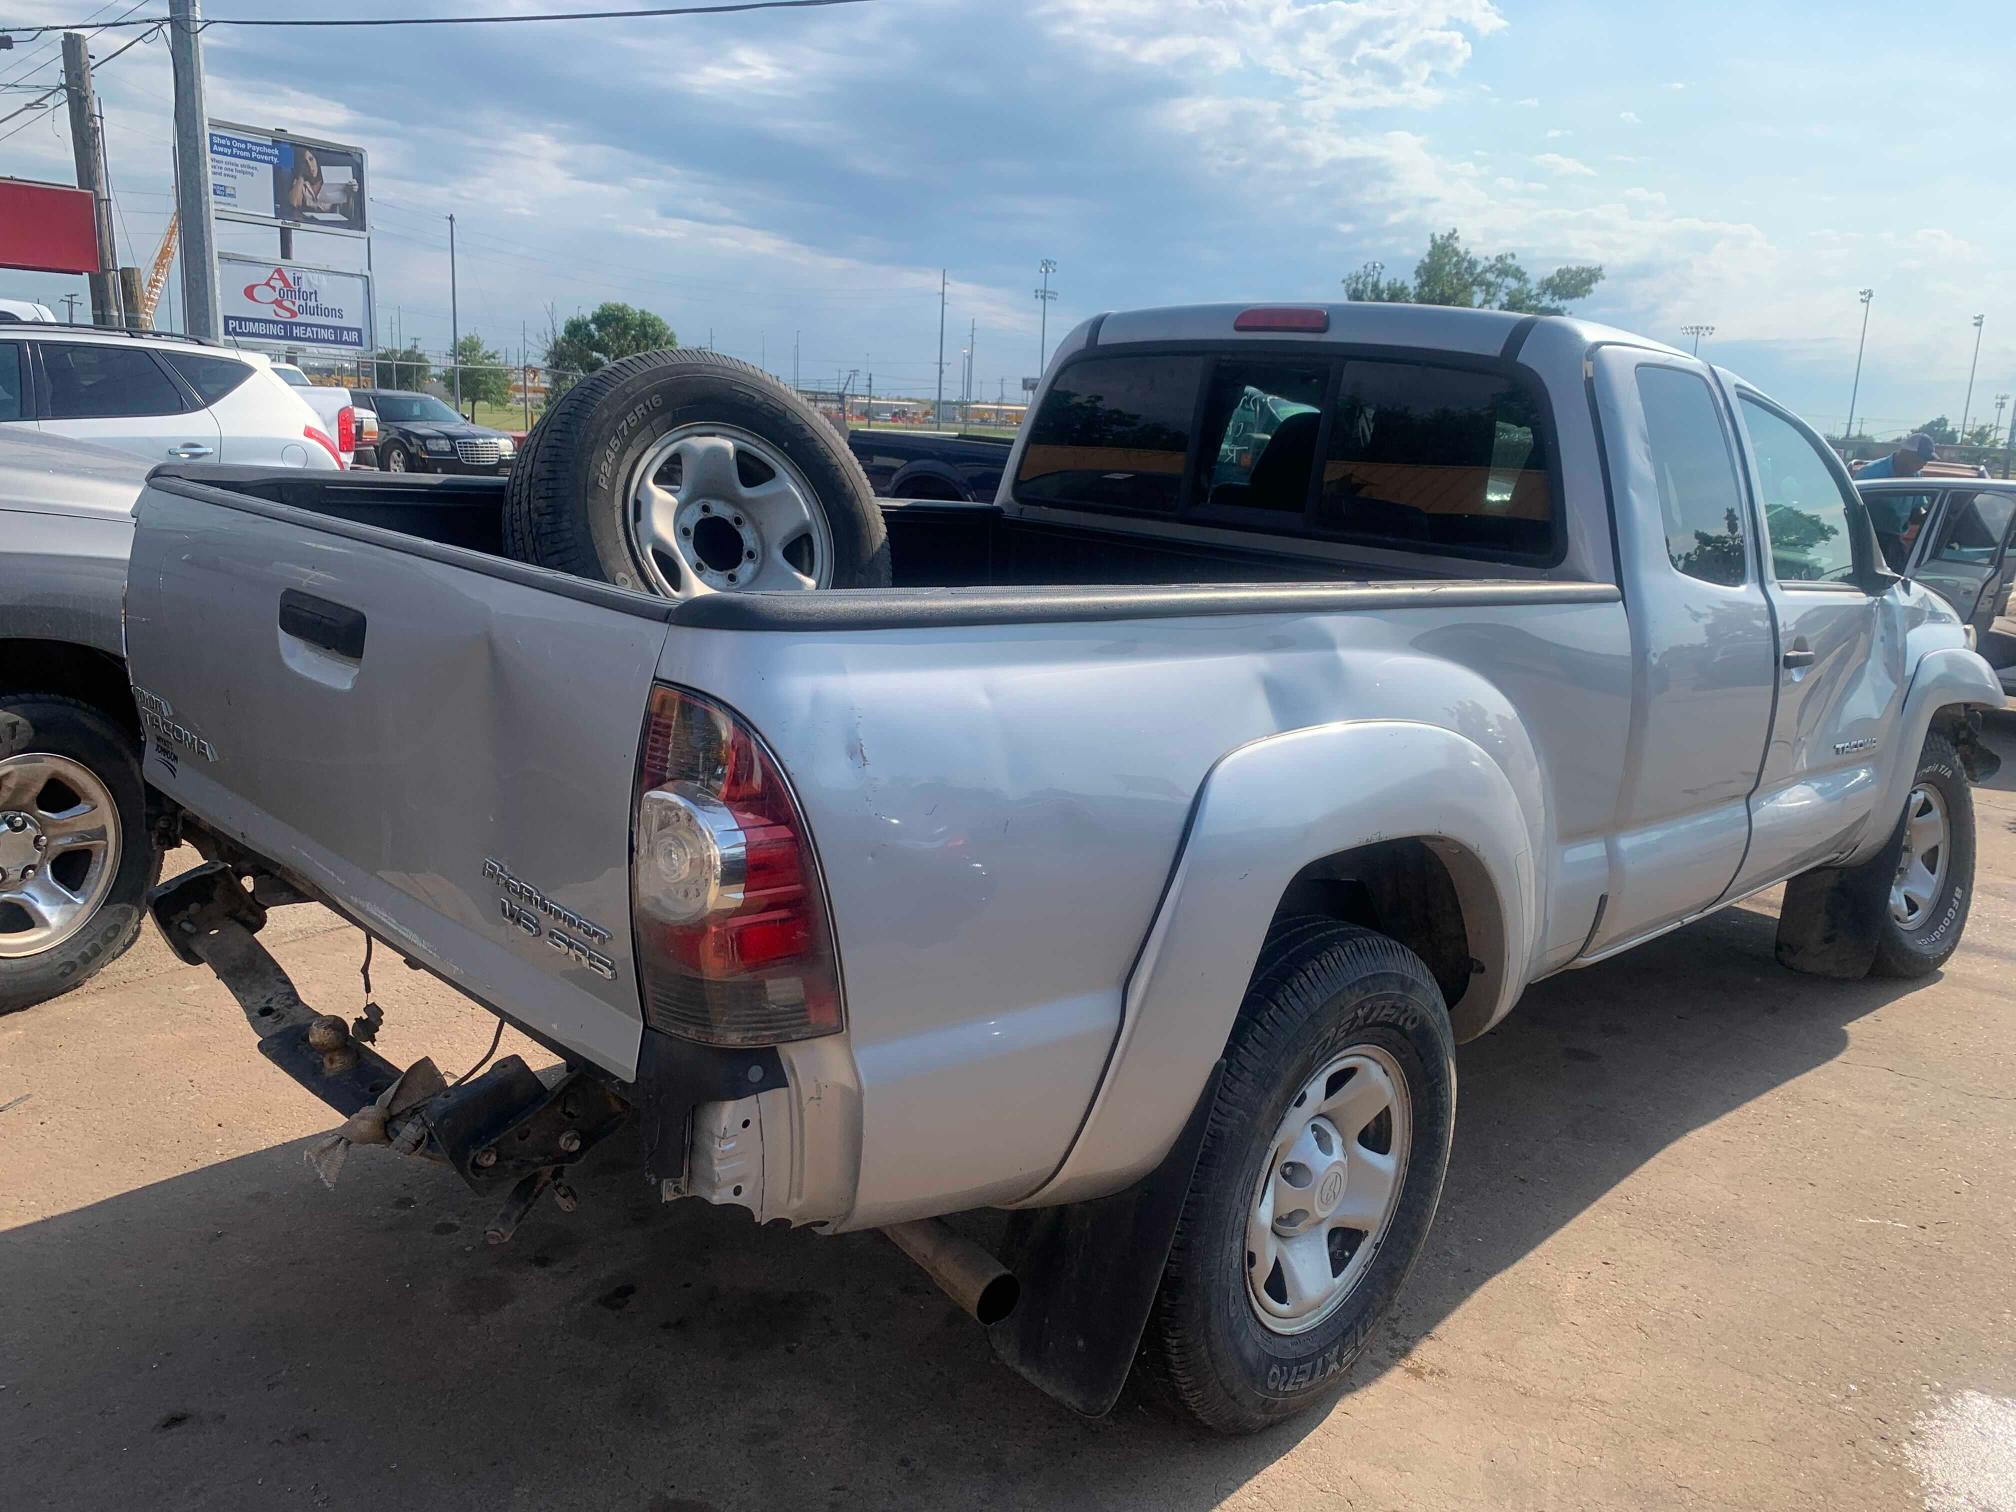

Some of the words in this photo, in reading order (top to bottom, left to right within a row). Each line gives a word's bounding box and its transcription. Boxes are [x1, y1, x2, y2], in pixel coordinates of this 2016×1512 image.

[212, 136, 231, 146] She's
[232, 140, 246, 148] One
[247, 143, 279, 155] Paycheck
[212, 144, 232, 155] Away
[232, 148, 251, 158] From
[251, 152, 279, 165] Poverty.
[262, 267, 302, 289] Air
[243, 283, 319, 305] Comfort
[273, 299, 344, 320] Solutions
[228, 320, 285, 337] PLUMBING
[293, 326, 335, 341] HEATING
[342, 332, 359, 343] AIR
[597, 393, 663, 492] P245/75R16
[142, 705, 219, 763] TACOMA
[482, 857, 614, 945] PreRunner
[500, 897, 542, 937] V6
[545, 927, 618, 981] SR5
